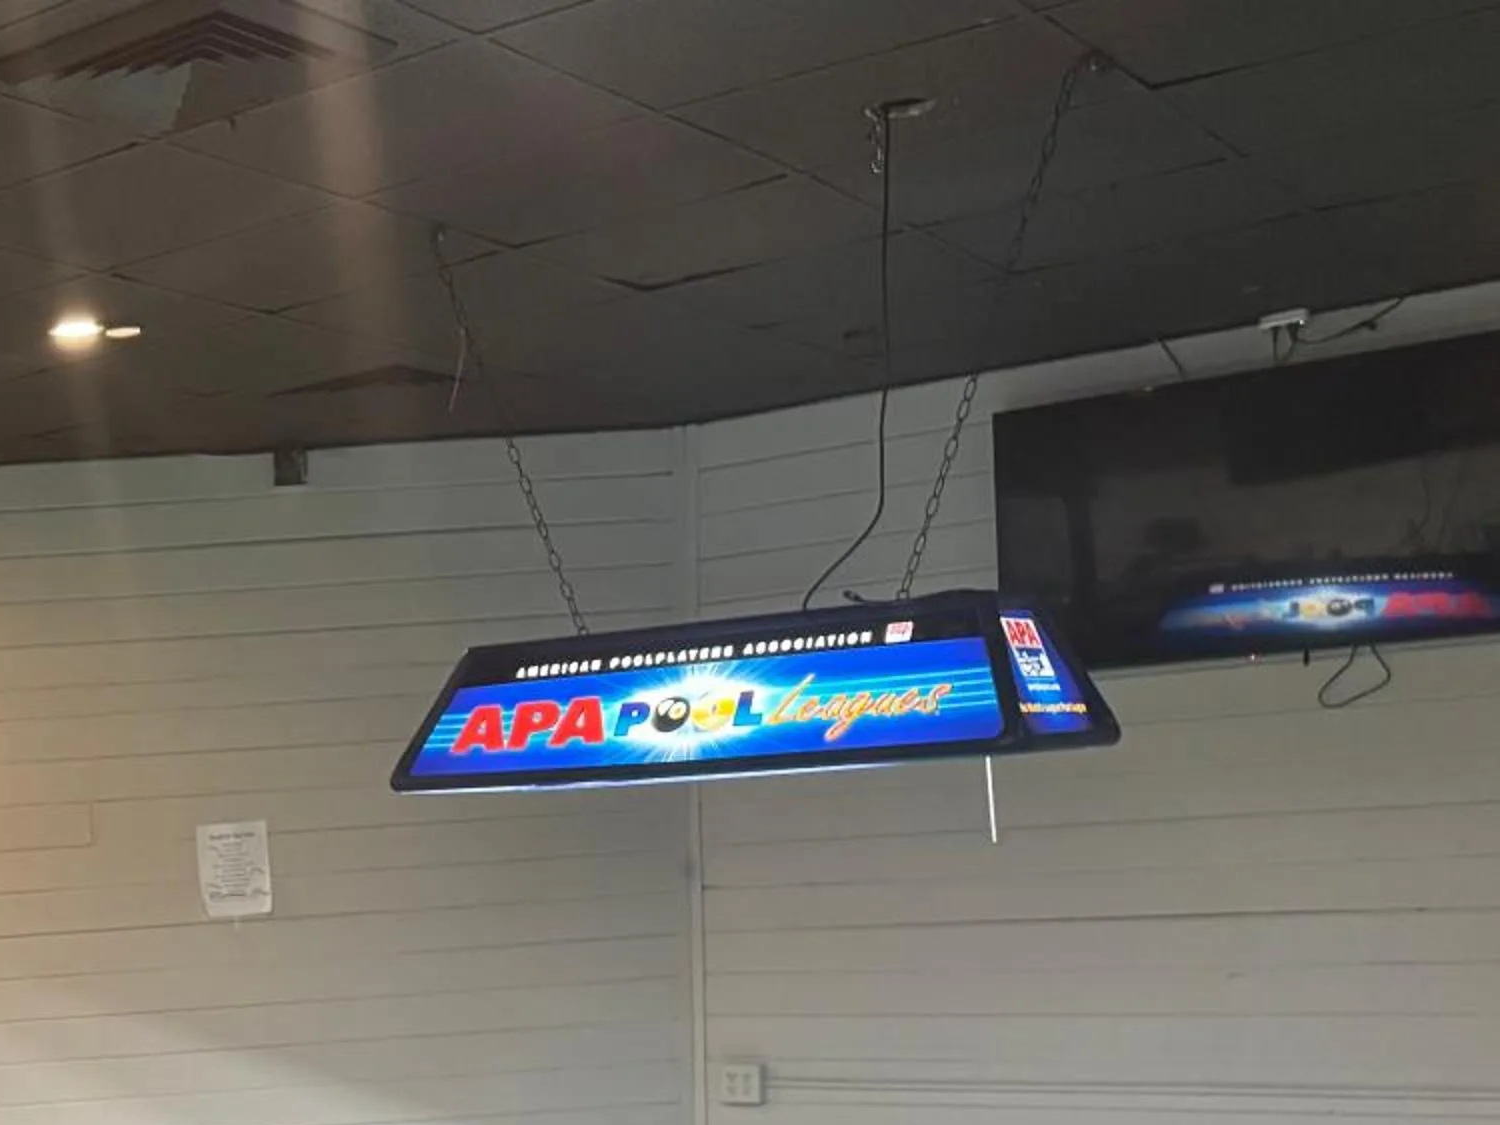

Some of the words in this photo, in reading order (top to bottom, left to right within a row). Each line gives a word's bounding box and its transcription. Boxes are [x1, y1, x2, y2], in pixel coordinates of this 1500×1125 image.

[1005, 619, 1043, 647] APA
[450, 695, 605, 756] APA
[613, 690, 763, 737] POOL
[765, 672, 953, 743] Leagues
